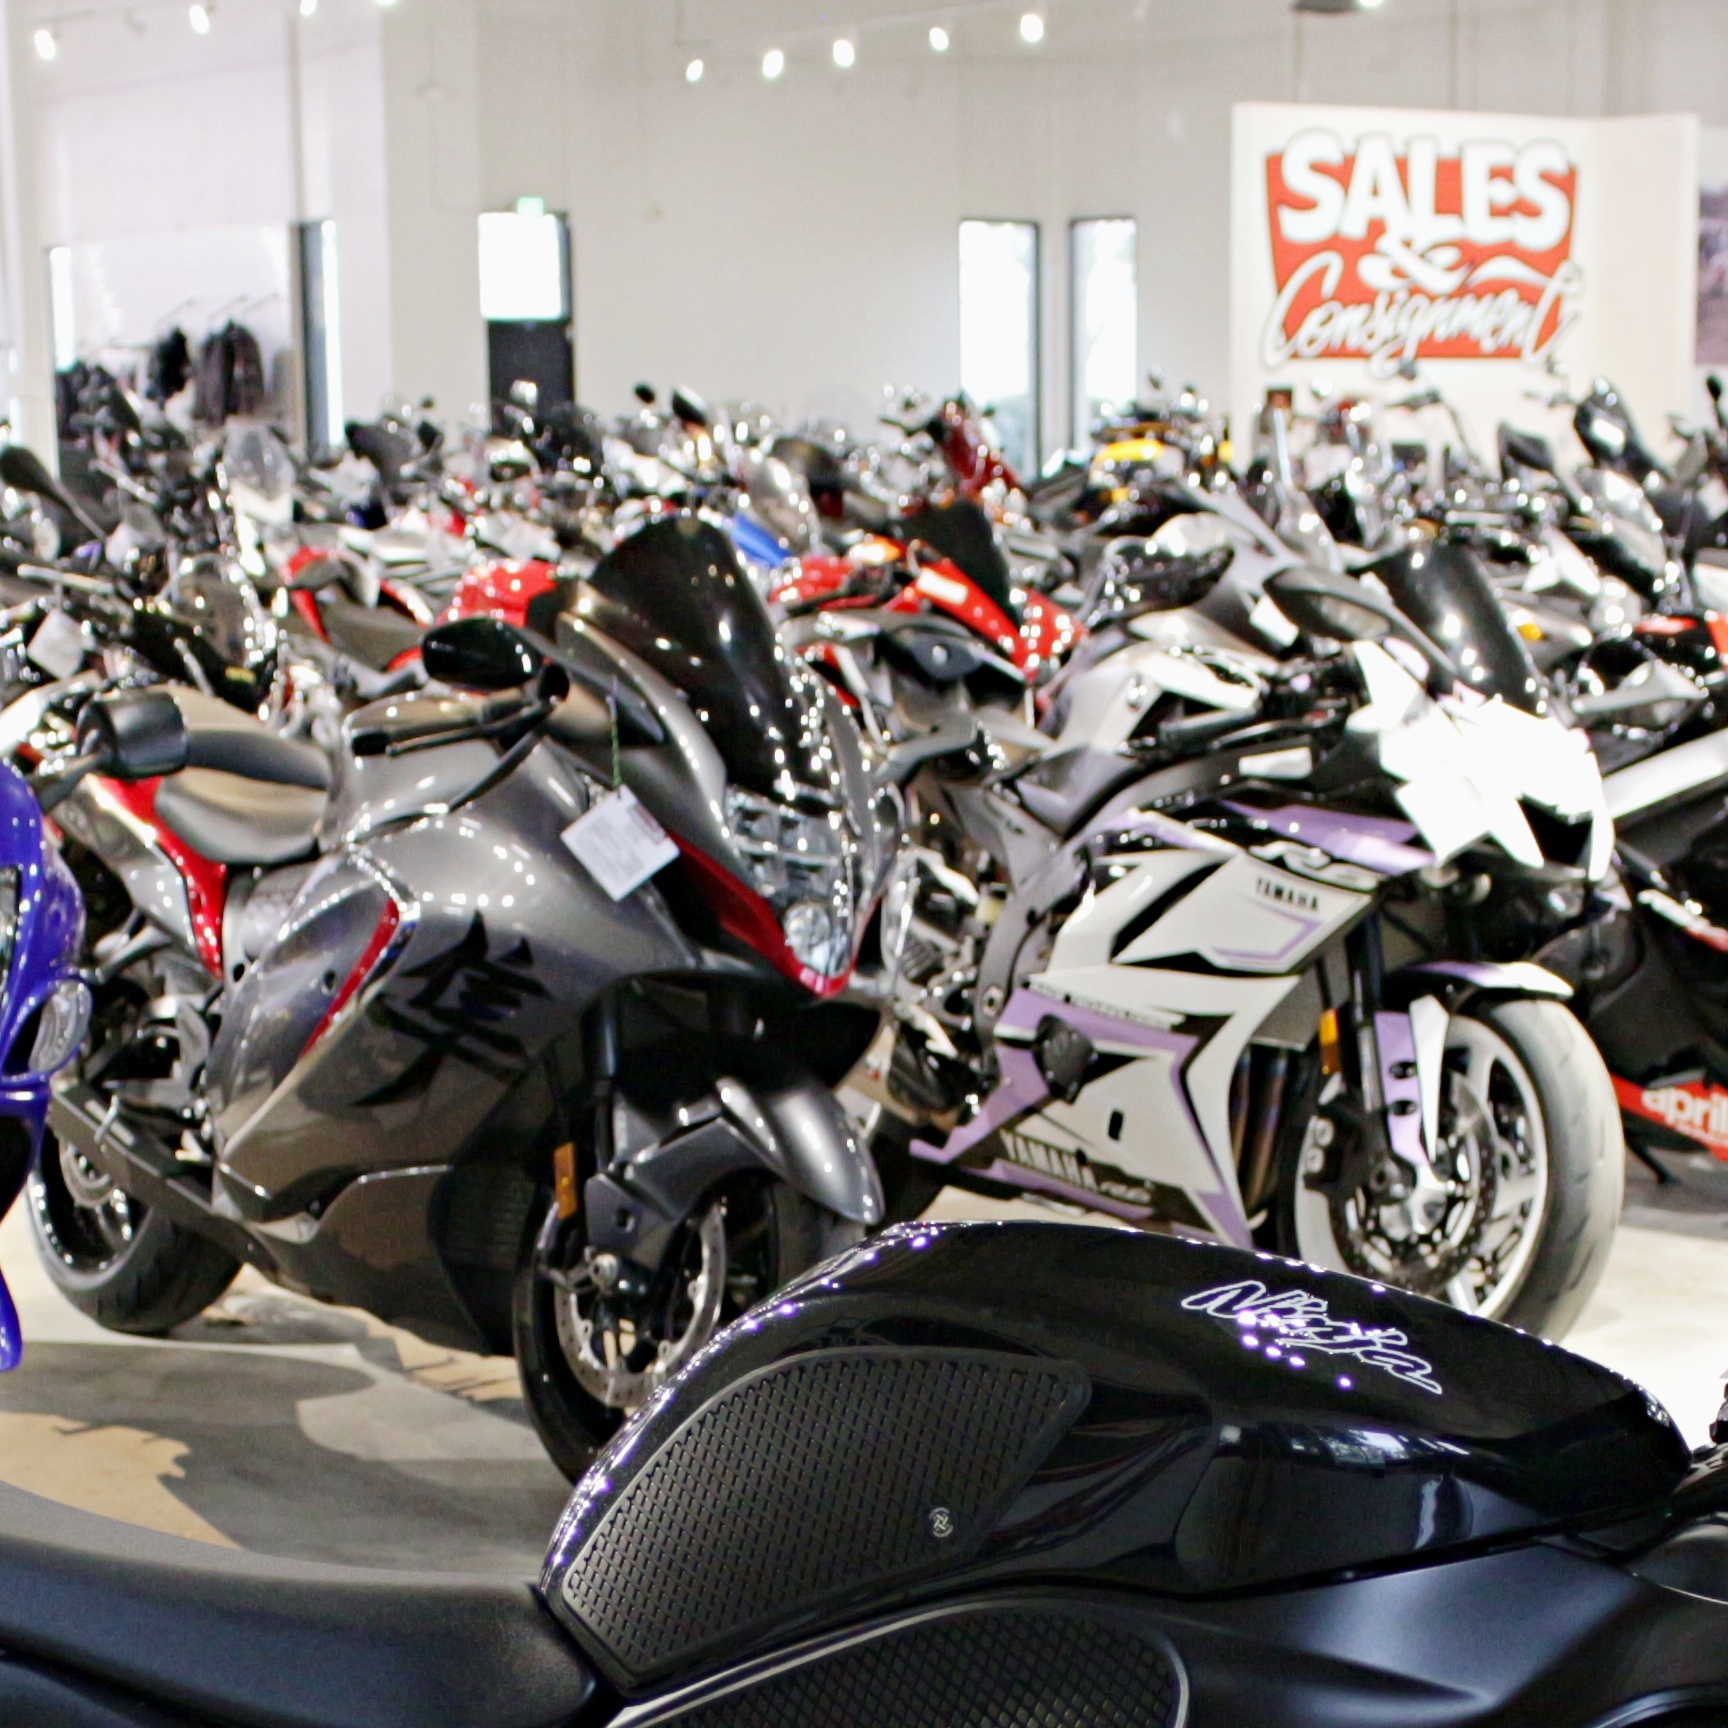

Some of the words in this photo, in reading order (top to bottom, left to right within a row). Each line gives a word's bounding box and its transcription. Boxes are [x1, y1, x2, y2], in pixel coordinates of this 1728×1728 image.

[1276, 126, 1574, 251] SALES
[1259, 250, 1586, 380] Consignment
[1255, 876, 1319, 911] YAMAHA
[998, 1128, 1102, 1193] YAMAHA
